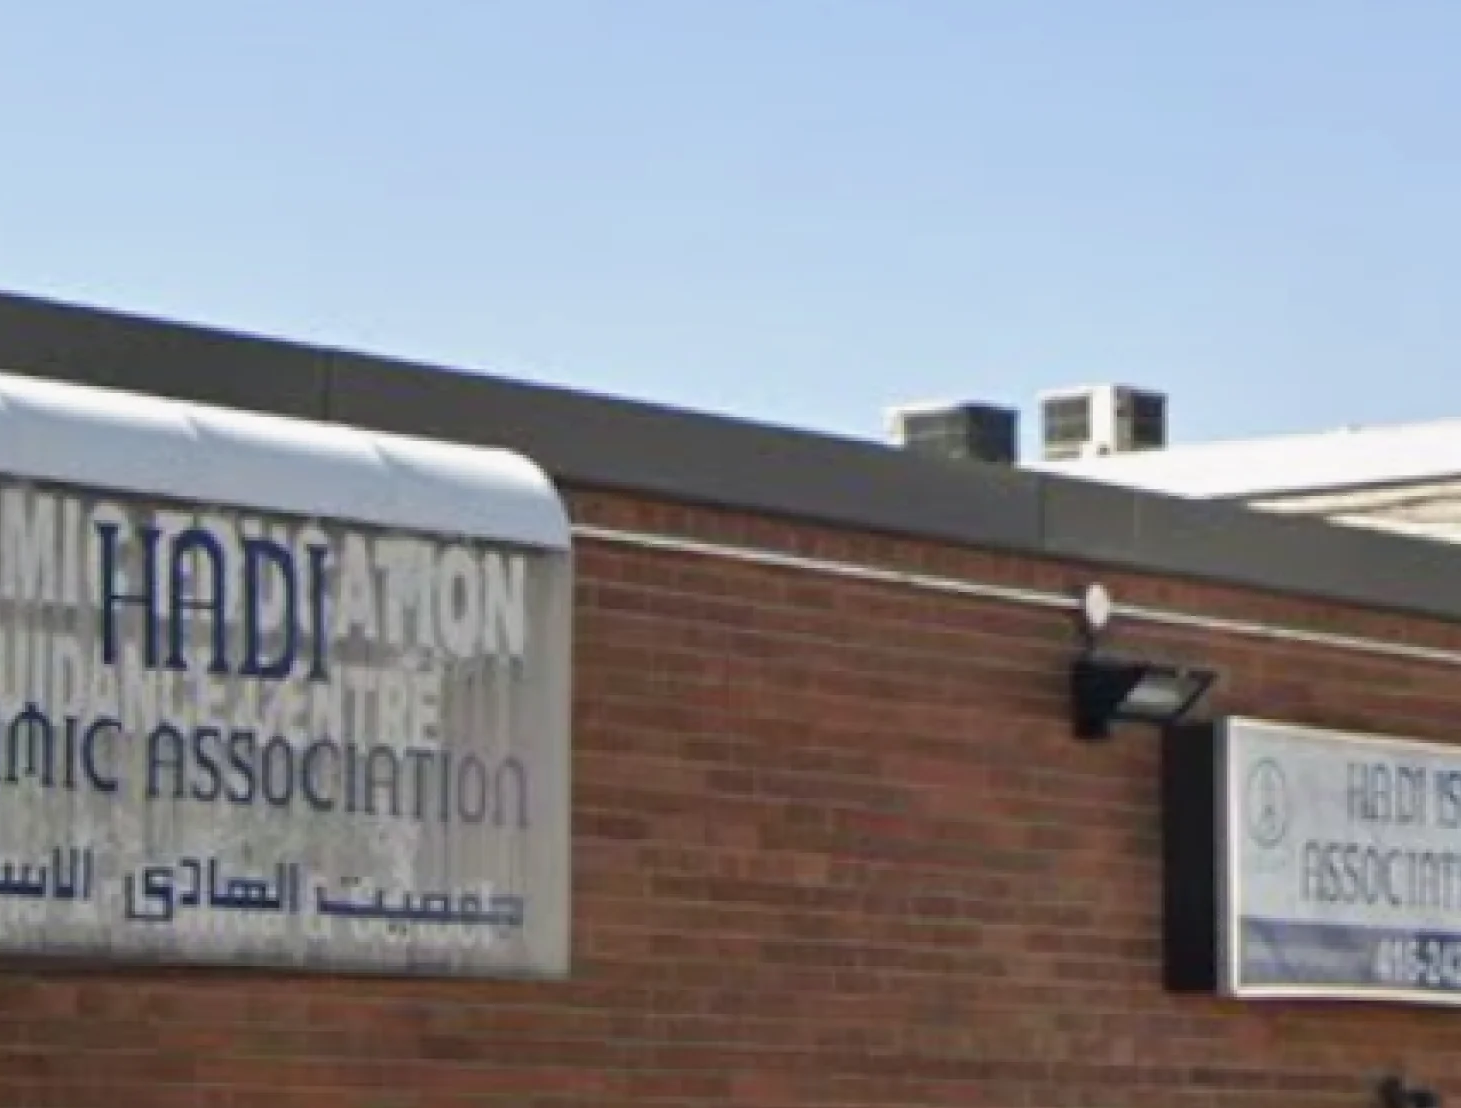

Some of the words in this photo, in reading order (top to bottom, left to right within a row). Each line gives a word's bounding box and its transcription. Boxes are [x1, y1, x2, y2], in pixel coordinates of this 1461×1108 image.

[95, 522, 328, 683] HADI
[145, 717, 528, 828] ASSOCIATION
[1346, 761, 1427, 825] HADI
